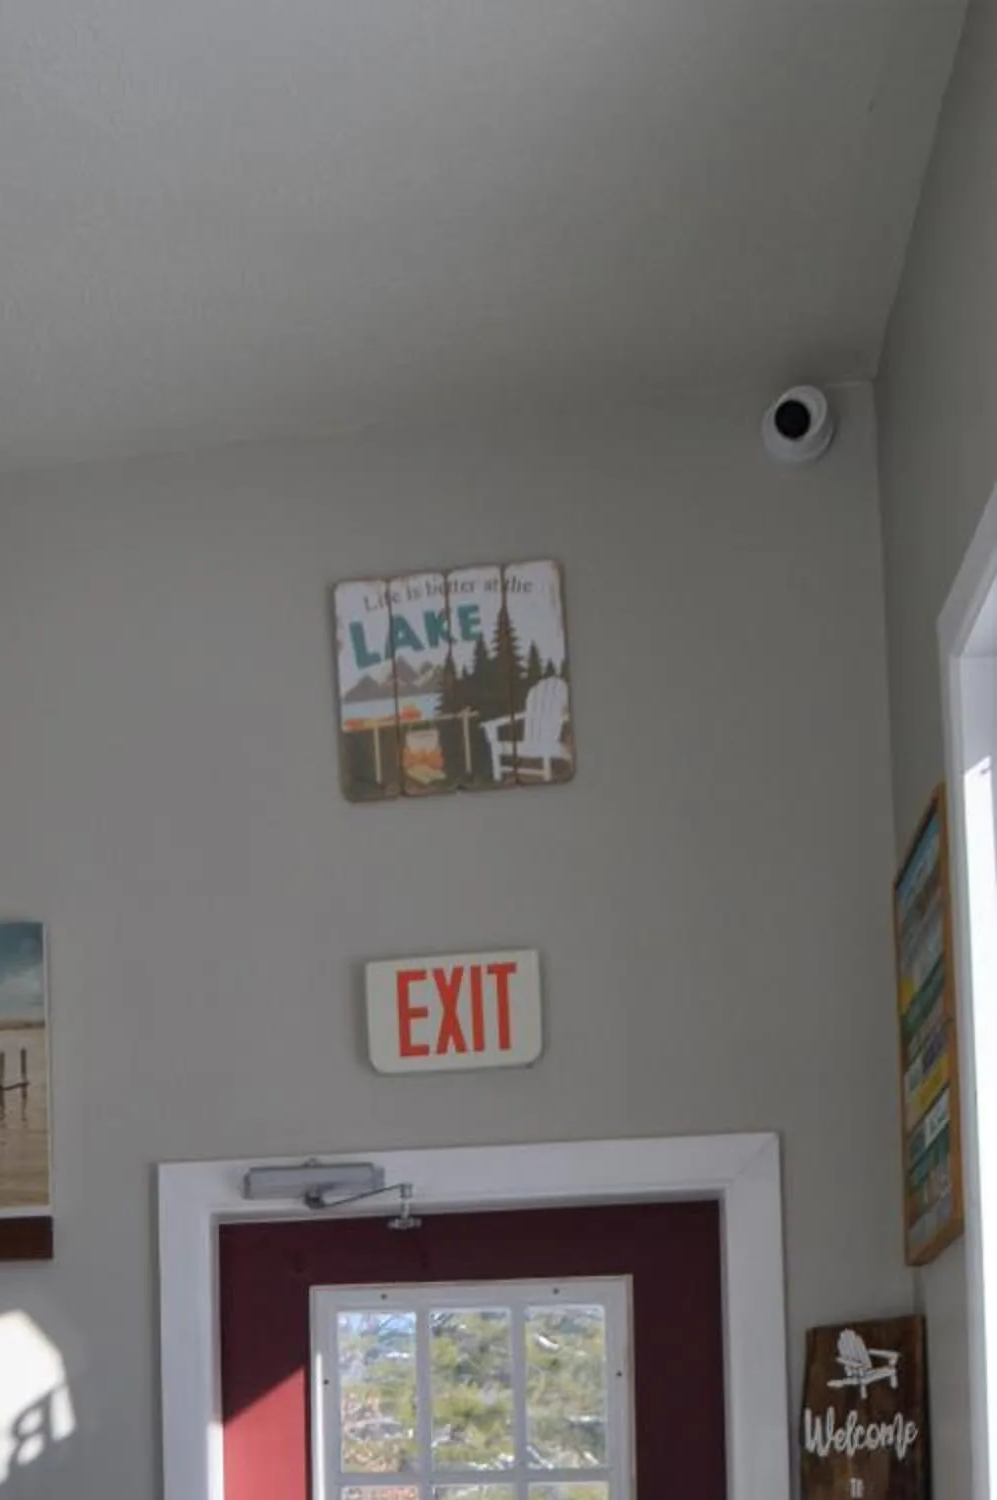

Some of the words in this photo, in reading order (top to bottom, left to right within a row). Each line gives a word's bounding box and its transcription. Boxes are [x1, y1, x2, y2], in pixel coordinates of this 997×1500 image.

[484, 578, 500, 593] at
[349, 604, 481, 670] LAKE
[397, 961, 517, 1058] EXIT
[804, 1406, 919, 1461] Welcome
